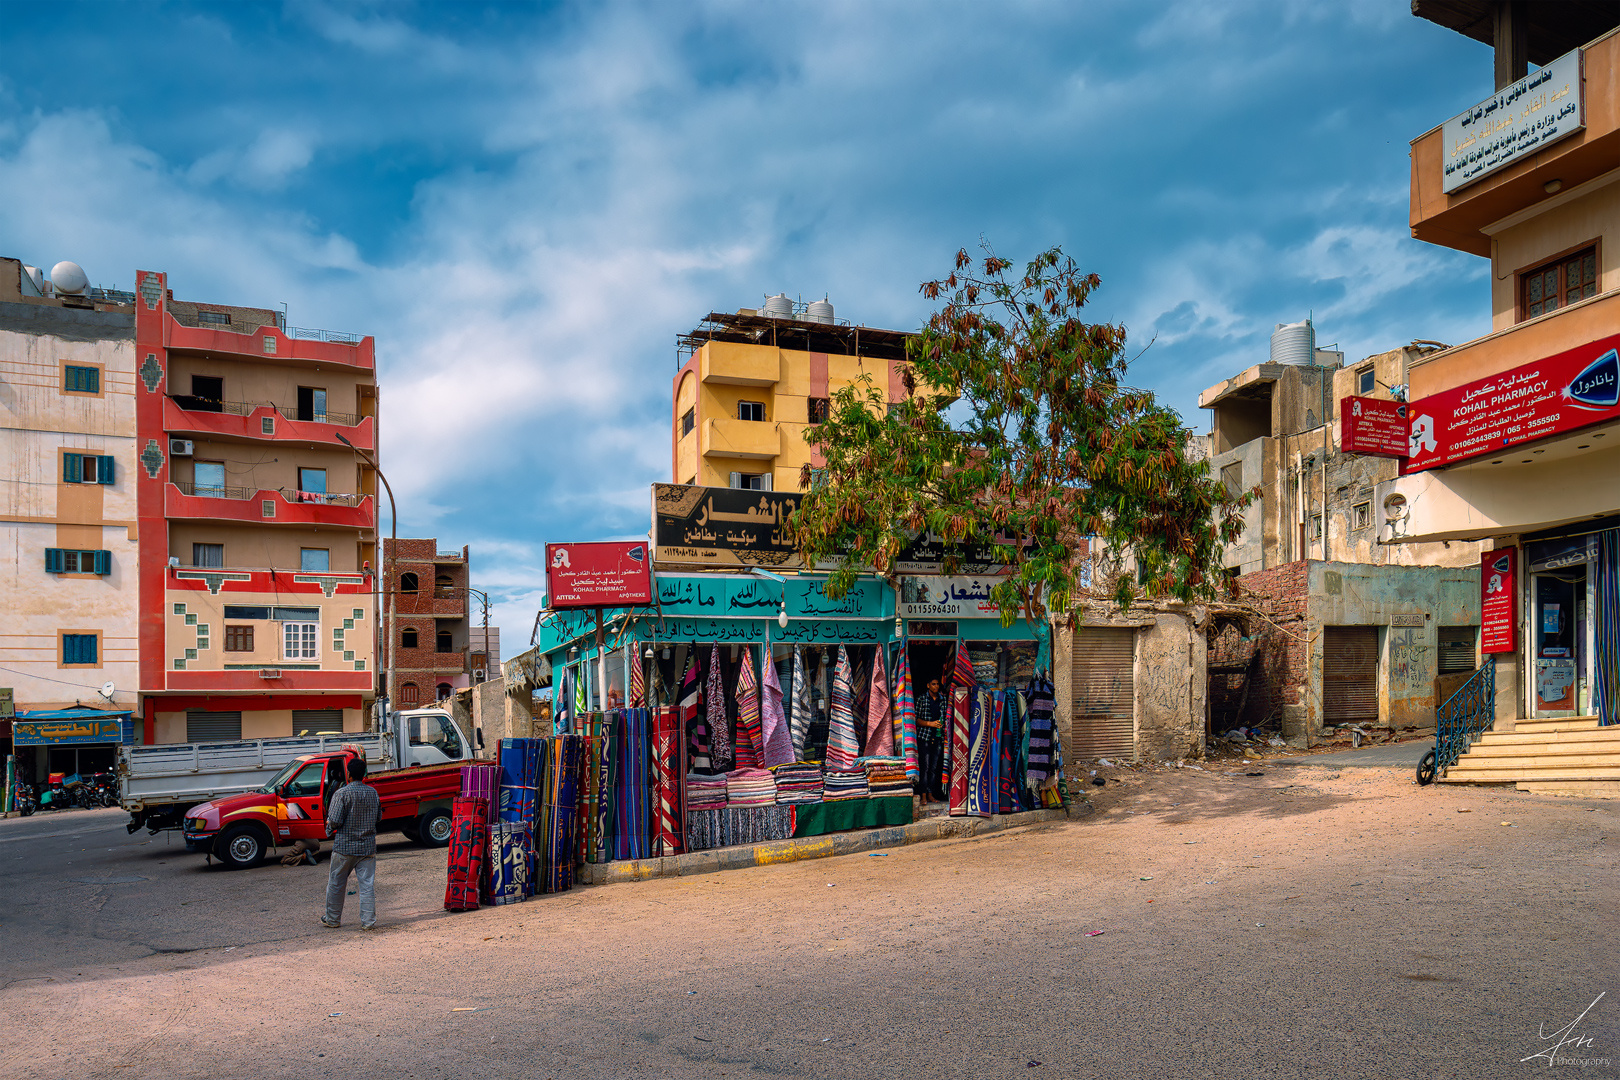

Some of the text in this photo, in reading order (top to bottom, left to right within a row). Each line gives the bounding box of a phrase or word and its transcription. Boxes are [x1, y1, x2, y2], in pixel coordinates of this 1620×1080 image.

[1528, 70, 1553, 93] محاسب
[1550, 83, 1570, 103] عبد
[1483, 97, 1499, 119] خبير
[1517, 91, 1547, 124] القادر
[1556, 102, 1576, 121] وكيل
[1536, 114, 1555, 130] وزارة
[1517, 136, 1540, 152] جمعية
[1461, 370, 1540, 404] صيدلية كحيل
[1574, 372, 1614, 395] بانادول
[1453, 380, 1549, 418] KOHAIL PHARMACY
[1502, 402, 1521, 412] محمد
[1526, 391, 1557, 407] الدكتور
[1469, 412, 1487, 425] القادر
[1488, 408, 1501, 417] عبد
[1513, 408, 1536, 422] توصيل
[1447, 418, 1469, 431] كحيل
[1488, 416, 1512, 428] الطلبات
[1454, 431, 1501, 450] 01062443839
[1507, 424, 1521, 435] 065
[1527, 413, 1561, 429] 3555503
[1509, 426, 1556, 443] KOHAIL PHARMACY
[1463, 444, 1489, 456] PHARMACY
[683, 527, 717, 546] بطاطين
[726, 529, 757, 546] موكيت
[570, 577, 624, 586] صيدلية كحيل
[662, 580, 681, 598] الله
[697, 583, 716, 607] ما
[727, 581, 783, 614] بسم الله
[907, 605, 960, 614] 01155964301
[682, 620, 745, 640] مفروشات
[773, 622, 878, 642] تخفيضات كل خميس
